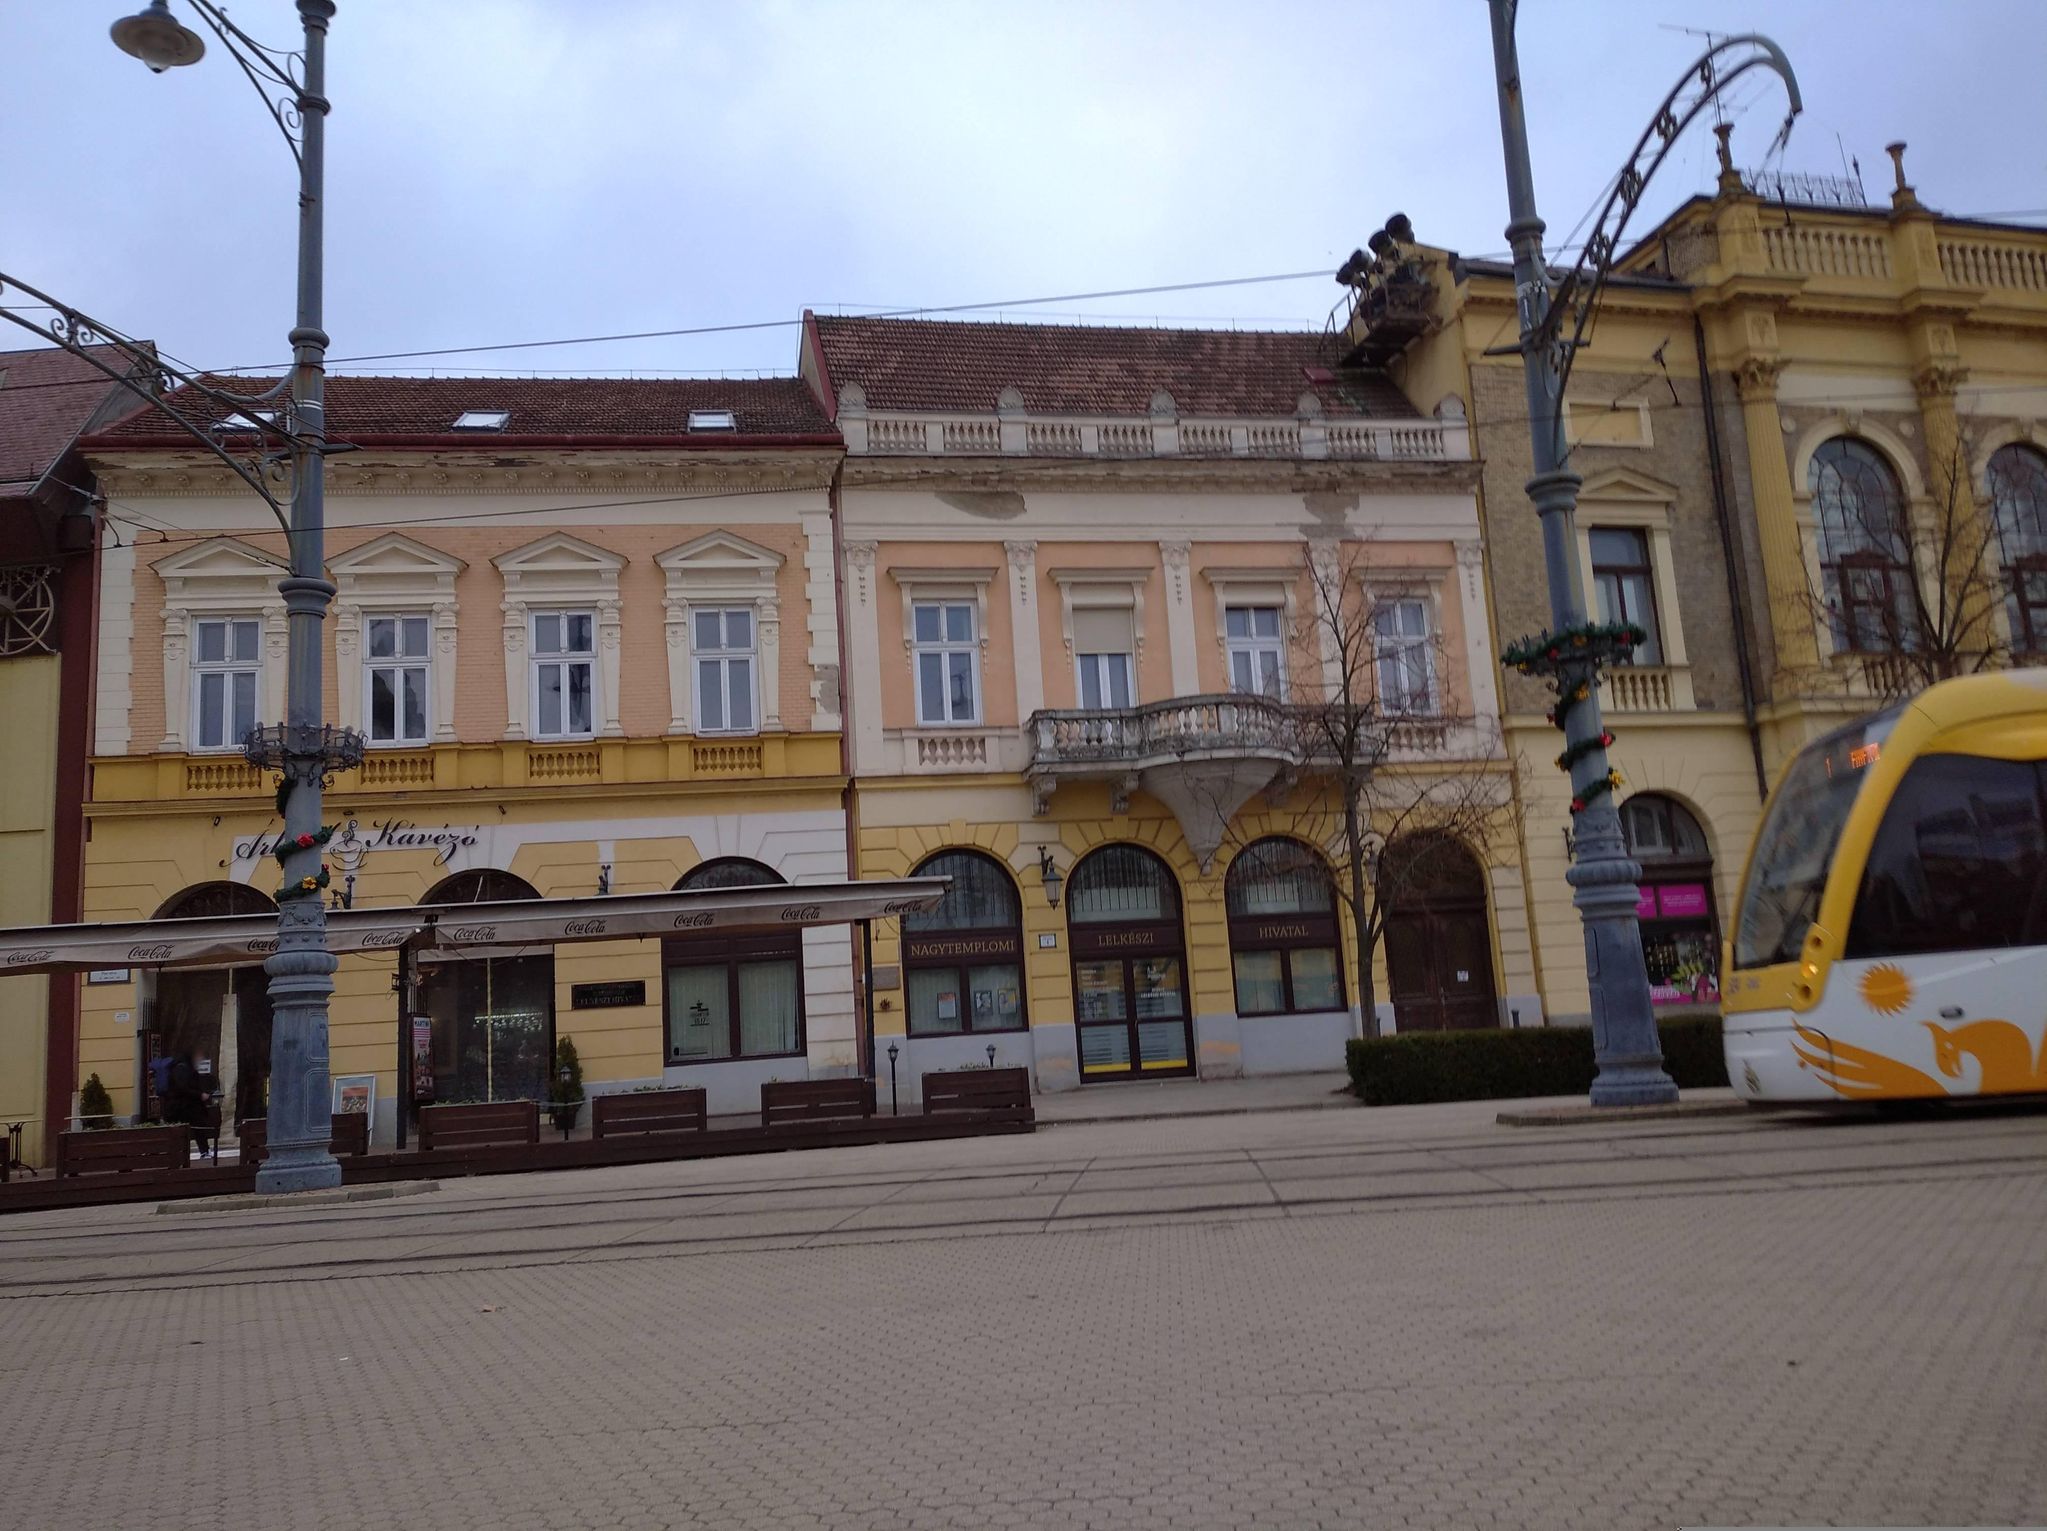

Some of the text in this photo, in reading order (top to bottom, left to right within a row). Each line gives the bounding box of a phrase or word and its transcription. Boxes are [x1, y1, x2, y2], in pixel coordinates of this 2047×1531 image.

[366, 817, 480, 867] Kávézó
[1098, 931, 1154, 947] LELKÉSZI
[1259, 925, 1309, 939] HIVATAL
[911, 939, 1015, 957] NAGYTEMPLOMI
